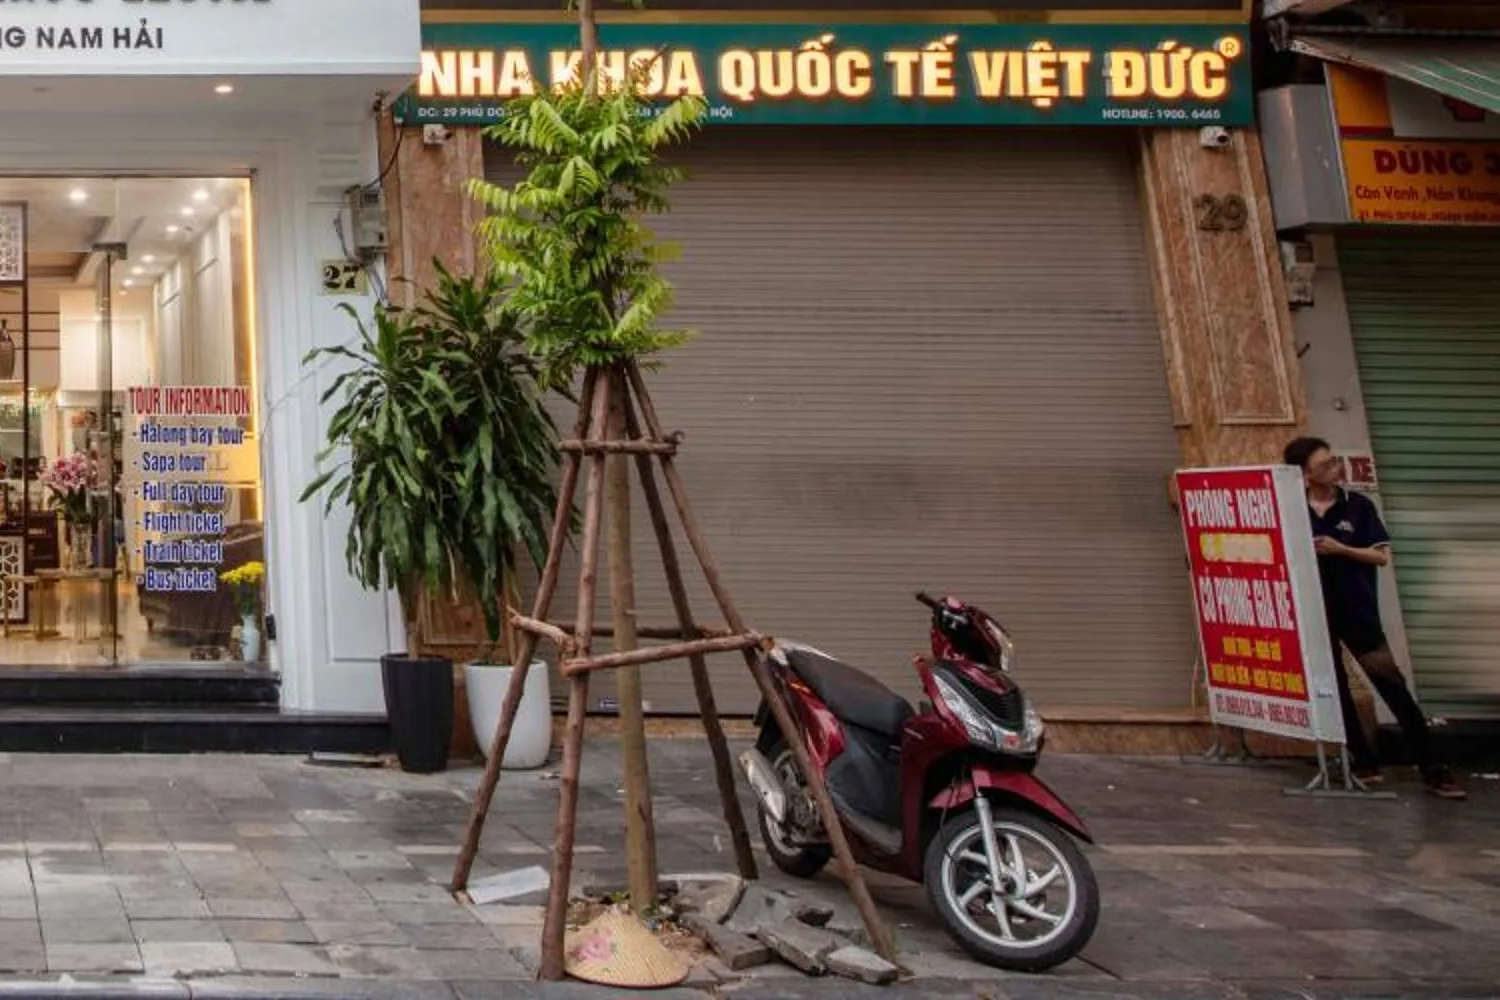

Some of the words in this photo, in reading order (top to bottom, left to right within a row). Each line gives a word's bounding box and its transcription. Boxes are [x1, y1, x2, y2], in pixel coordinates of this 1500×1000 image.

[37, 27, 103, 49] NAM
[114, 18, 164, 49] HẢI
[418, 49, 535, 97] NHA
[549, 49, 704, 97] KHOA
[719, 33, 871, 101] QUỐC
[884, 33, 959, 98] TẾ
[970, 40, 1092, 108] VIỆT
[1103, 40, 1227, 98] ĐỨC
[1194, 192, 1248, 232] 29
[323, 264, 360, 289] 27
[129, 386, 161, 415] TOUR
[165, 386, 252, 415] INFORMATION
[141, 423, 188, 447] Halong
[191, 423, 214, 446] bay
[217, 425, 244, 445] tour
[142, 451, 176, 473] Sapa
[179, 453, 206, 472] tour
[143, 481, 167, 501] Full
[171, 481, 195, 504] day
[199, 483, 224, 503] tour
[1184, 479, 1237, 528] PHÒNG
[1235, 474, 1277, 529] NGHỈ
[145, 511, 181, 533] Flight
[184, 511, 224, 533] ticket
[145, 540, 182, 562] Train
[183, 541, 223, 562] ticket
[147, 568, 174, 591] Bus
[174, 568, 217, 590] ticket
[1212, 566, 1257, 627] PHÒNG
[1252, 569, 1278, 629] GIÁ
